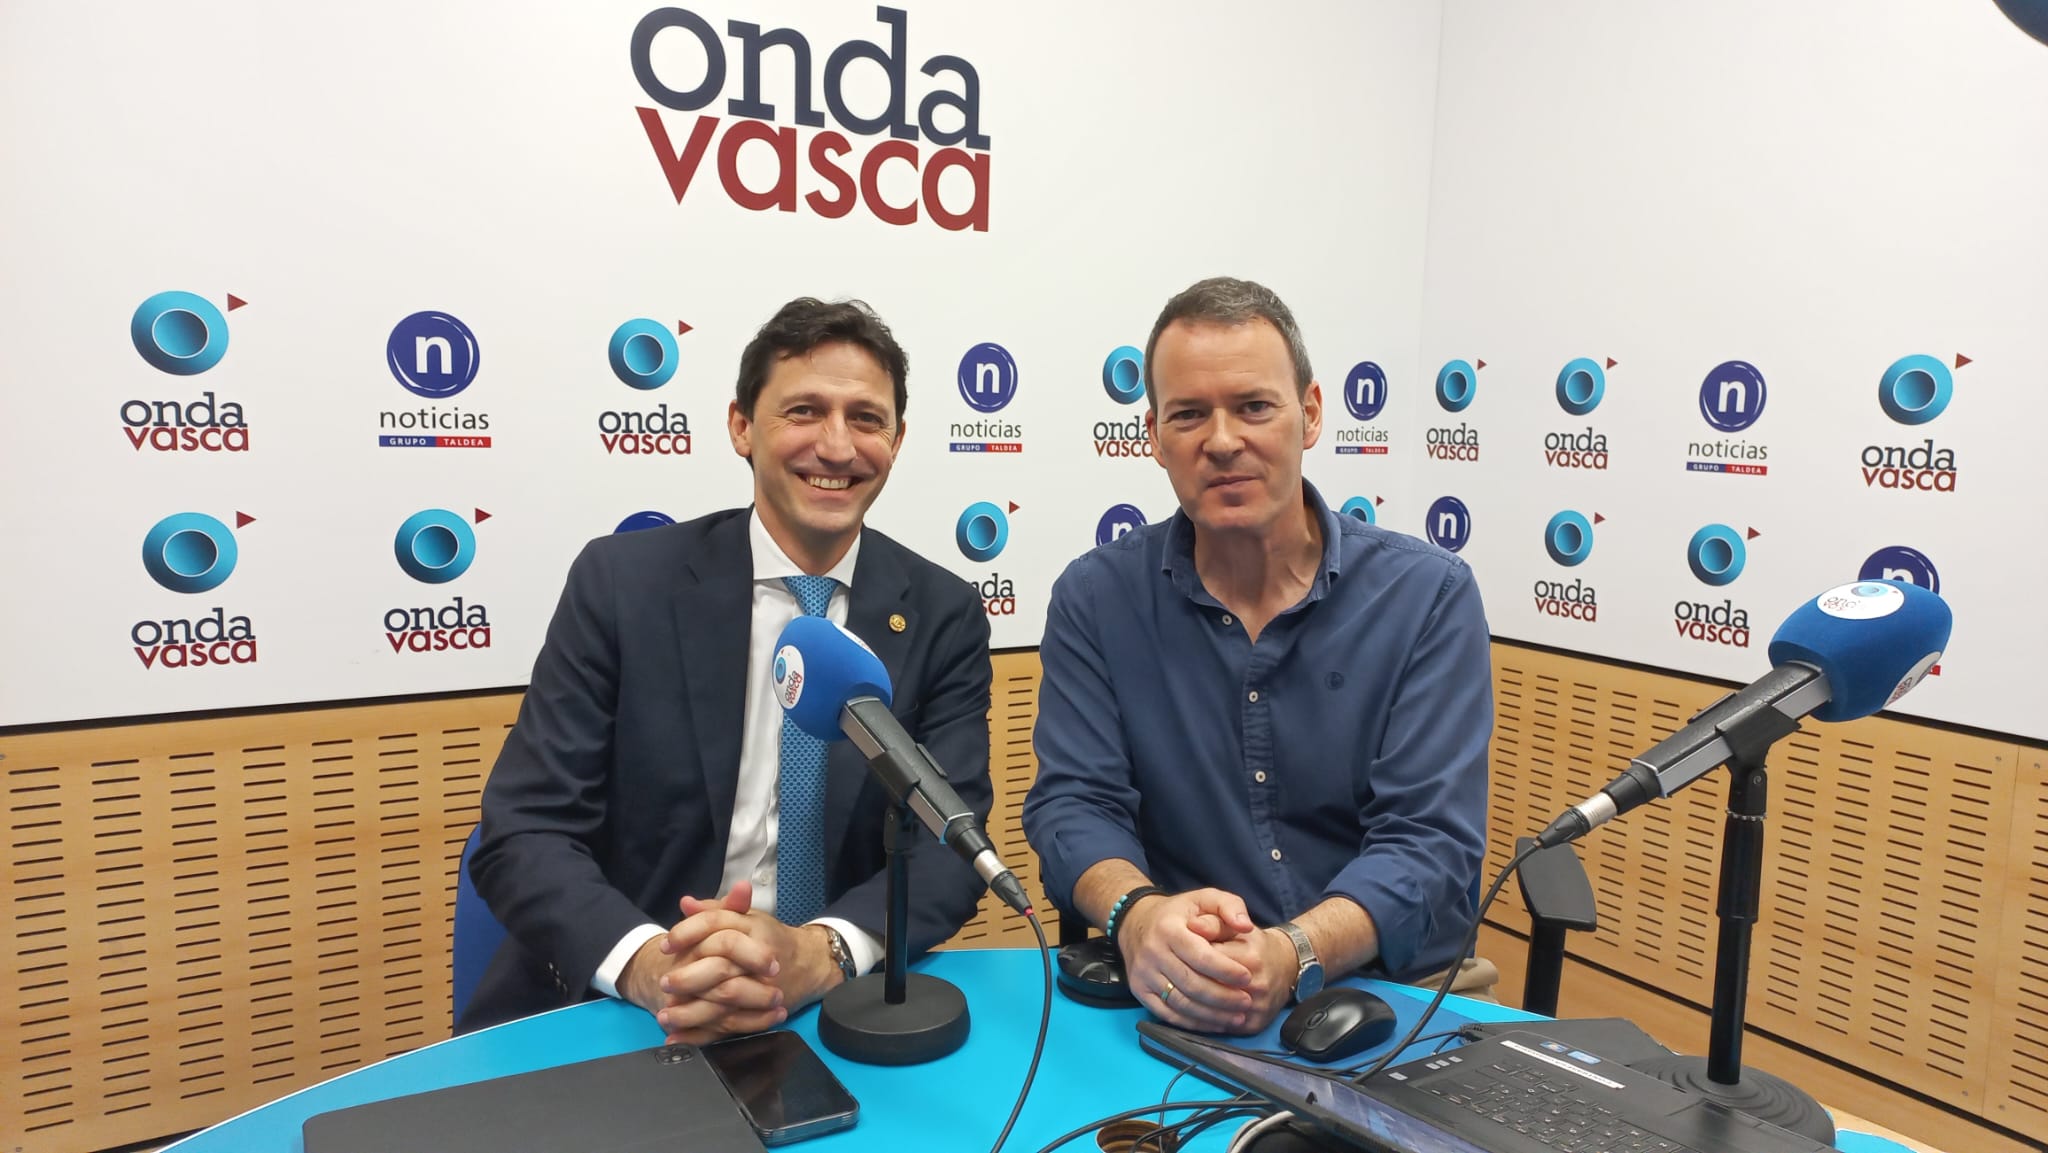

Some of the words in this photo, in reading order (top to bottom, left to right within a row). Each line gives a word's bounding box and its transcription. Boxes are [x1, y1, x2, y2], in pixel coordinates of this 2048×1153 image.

[630, 5, 991, 151] onda
[635, 106, 990, 233] vasca
[415, 335, 453, 374] n
[975, 361, 999, 394] n
[1356, 378, 1375, 405] n
[1717, 379, 1745, 413] n
[120, 392, 247, 428] onda
[379, 405, 490, 432] noticias
[599, 404, 691, 435] onda
[124, 426, 249, 452] vasca
[389, 437, 427, 446] GRUPO
[443, 437, 484, 446] TALDEA
[950, 419, 1022, 438] noticias
[1336, 426, 1389, 442] noticias
[1426, 422, 1478, 445] onda
[1544, 427, 1608, 454] onda
[600, 433, 691, 455] vasca
[956, 443, 981, 451] GRUPO
[991, 443, 1018, 451] TALDEA
[1427, 444, 1479, 462] vasca
[1688, 439, 1768, 461] noticias
[1861, 440, 1957, 471] onda
[1545, 449, 1608, 470] vasca
[1693, 463, 1720, 472] GRUPO
[1732, 465, 1763, 475] TALDEA
[1862, 466, 1957, 493] vasca
[1438, 512, 1458, 540] n
[972, 573, 1015, 599] da
[1534, 579, 1596, 607] onda
[384, 597, 491, 631] onda
[1534, 599, 1596, 622] vasca
[1674, 600, 1750, 631] onda
[131, 607, 256, 647] onda
[385, 627, 491, 654] vasca
[1675, 620, 1750, 648] vasca
[134, 640, 257, 670] vasca
